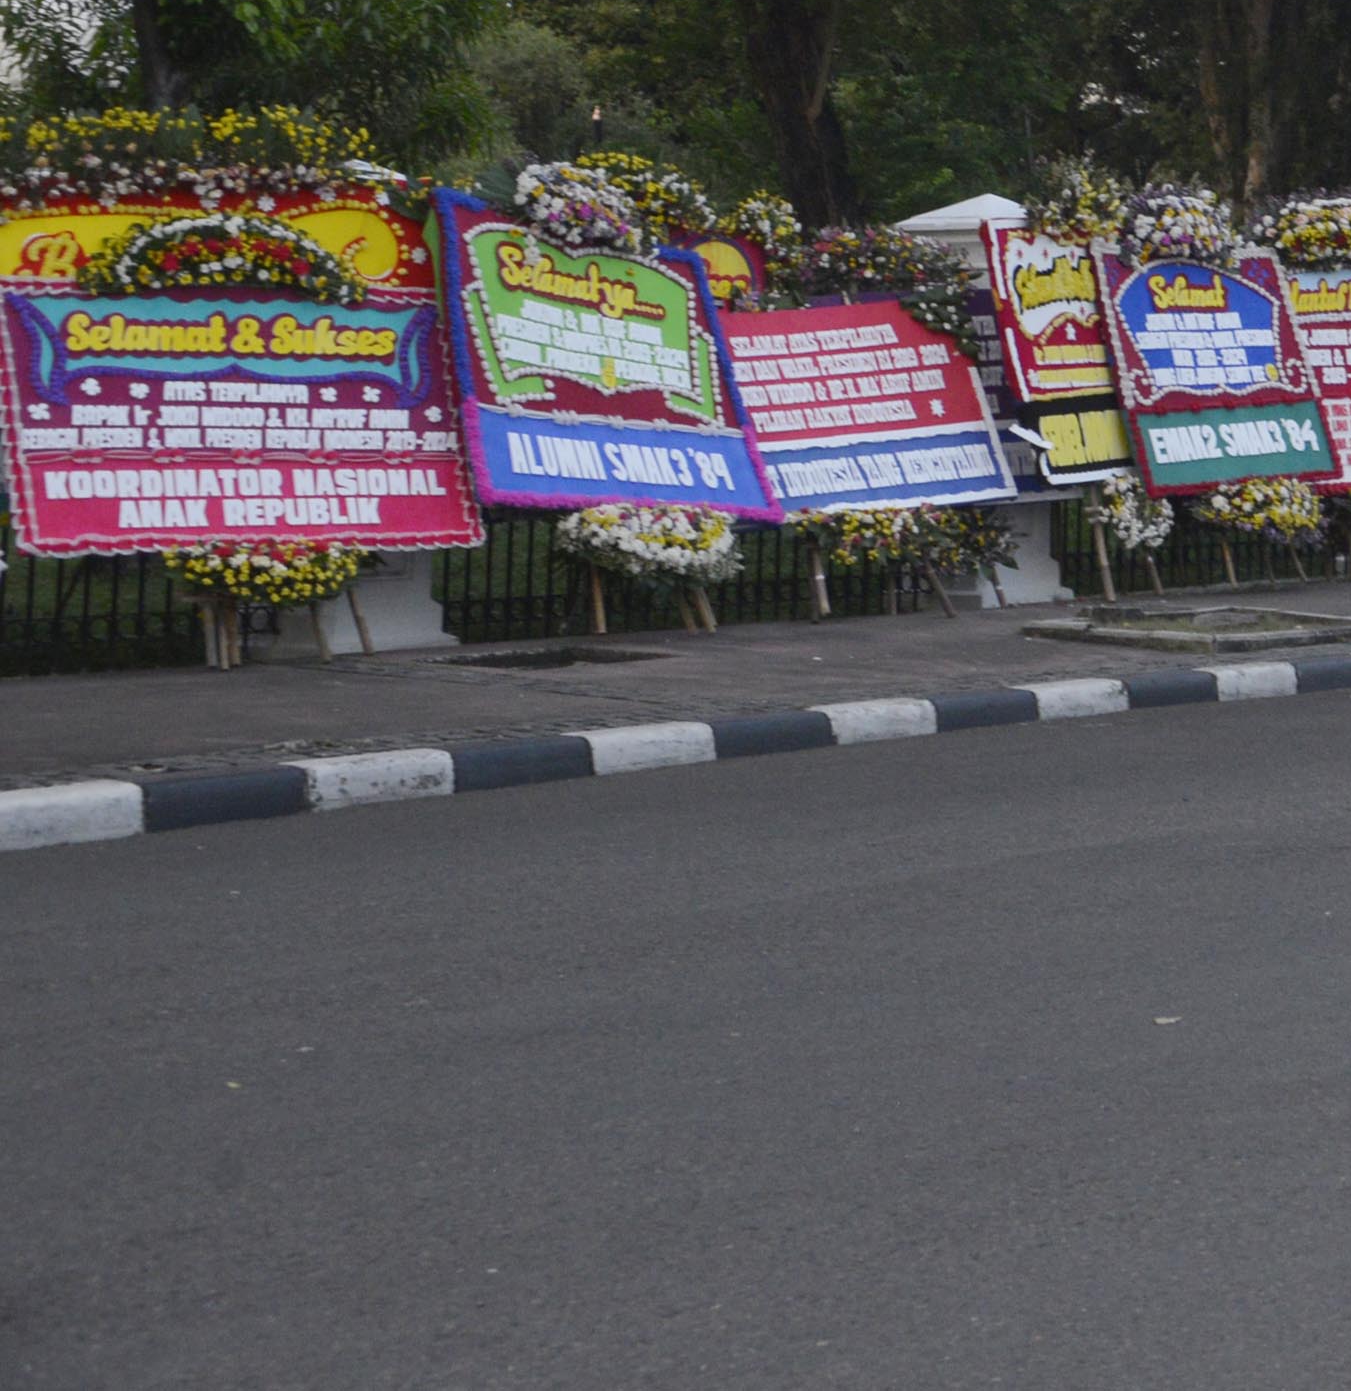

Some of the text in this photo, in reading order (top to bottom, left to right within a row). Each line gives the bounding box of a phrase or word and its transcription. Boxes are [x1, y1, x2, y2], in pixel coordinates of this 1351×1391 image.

[1147, 273, 1227, 310] Selamat
[66, 313, 398, 356] Selamat & Sukses
[506, 430, 608, 481] ALUMNI
[603, 441, 695, 488] SMAK3
[687, 446, 736, 491] '84
[1147, 423, 1223, 465] EMAK2
[1219, 418, 1288, 457] SMAK3
[43, 468, 447, 499] KOORDINATOR NASIONAL
[118, 497, 382, 528] ANAK REPUBLIK
